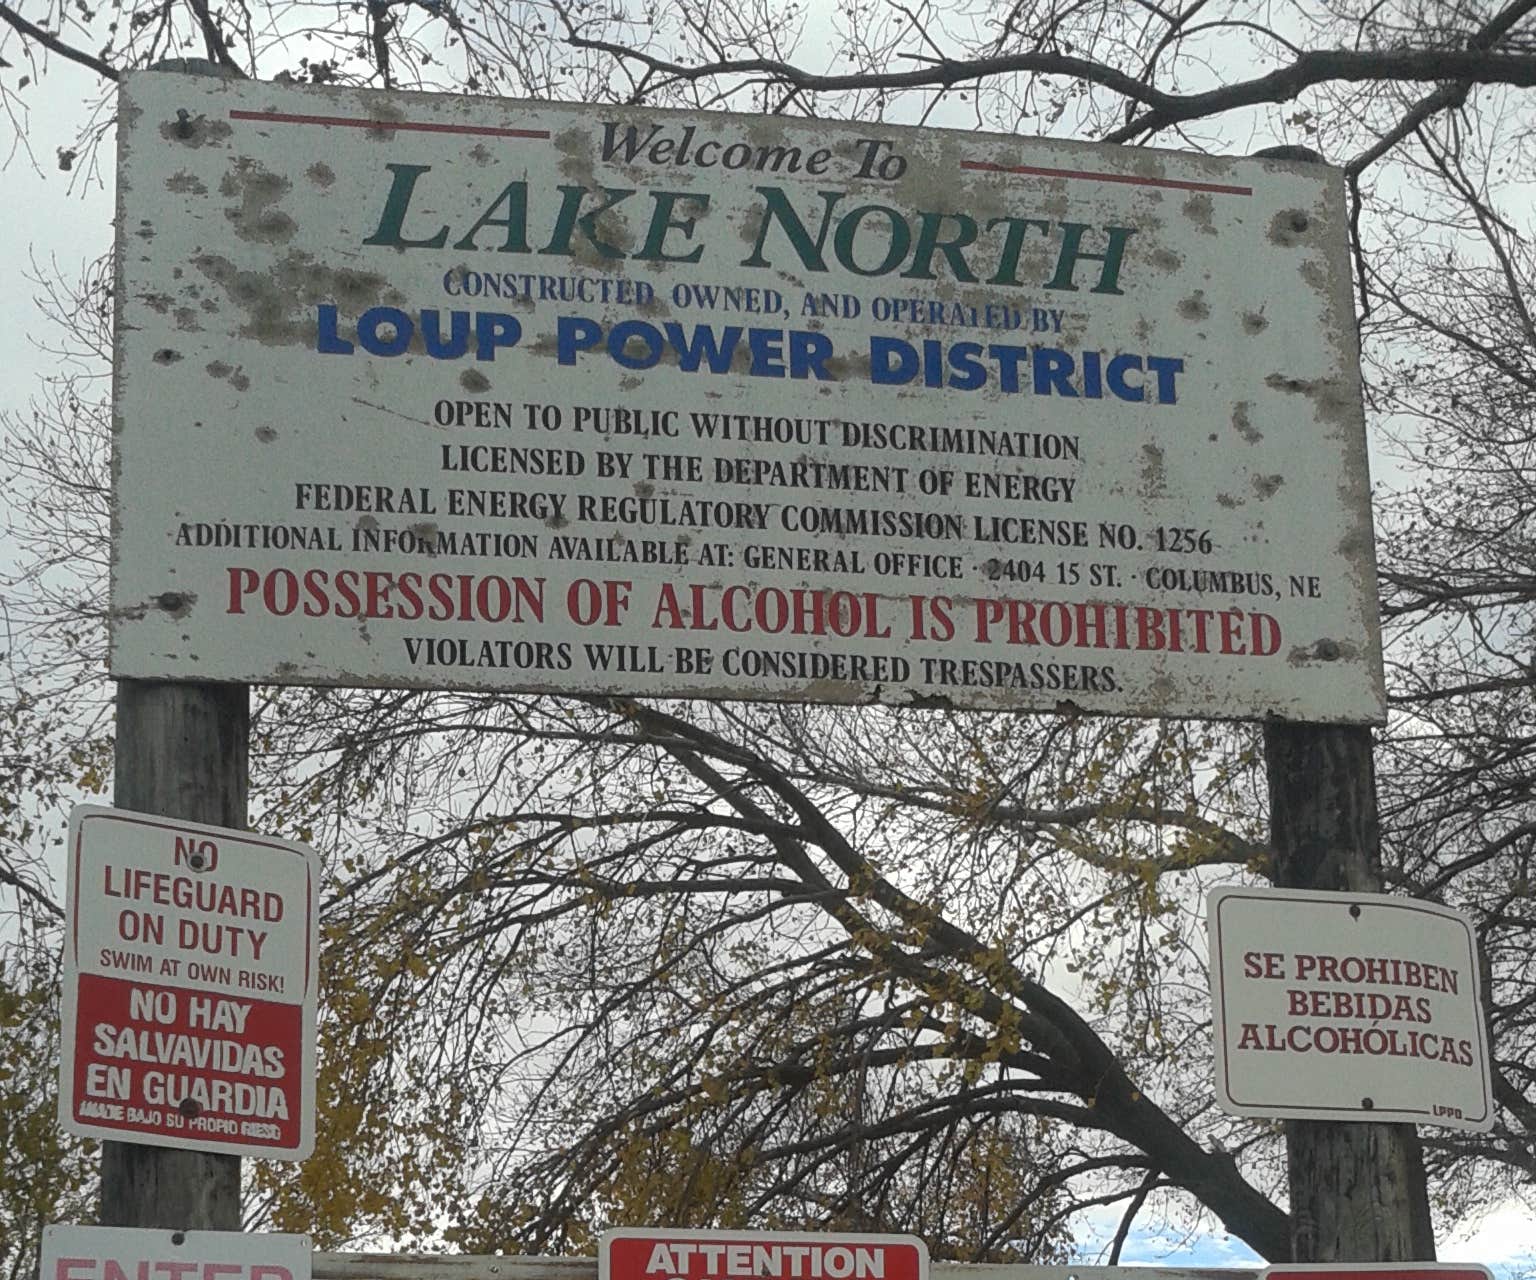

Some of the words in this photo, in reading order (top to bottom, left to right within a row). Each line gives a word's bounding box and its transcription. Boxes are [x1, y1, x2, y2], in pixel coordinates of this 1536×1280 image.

[601, 121, 833, 177] Welcome
[856, 138, 908, 182] To
[363, 162, 711, 263] LAKE
[739, 186, 1140, 296] NORTH
[672, 283, 789, 320] OWNED,
[801, 291, 861, 319] AND
[1033, 308, 1065, 333] BY
[317, 304, 522, 361] LOUP
[557, 315, 834, 380] POWER
[870, 336, 1184, 405] DISTRICT
[434, 399, 511, 429] OPEN
[523, 403, 562, 430] TO
[574, 406, 679, 438] PUBLIC
[690, 414, 830, 447] WITHOUT
[842, 421, 1080, 460] DISCRIMINATION
[441, 444, 584, 475] LICENSED
[597, 451, 632, 479] BY
[643, 453, 703, 482] THE
[714, 457, 908, 493] DEPARTMENT
[918, 468, 953, 495] OF
[965, 471, 1075, 503] ENERGY
[295, 483, 436, 518] FEDERAL
[447, 489, 568, 526] ENERGY
[577, 494, 770, 533] REGULATORY
[781, 505, 963, 540] COMMISSION
[973, 515, 1088, 547] LICENSE
[1098, 523, 1142, 550] NO.
[1155, 526, 1212, 554] 1256
[175, 522, 341, 551] ADDITIONAL
[352, 528, 536, 558] INFORMATION
[548, 537, 688, 564] AVAILABLE
[697, 544, 733, 567] AT:
[743, 546, 865, 573] GENERAL
[874, 553, 962, 578] OFFICE
[987, 558, 1046, 582] 2404
[1057, 561, 1079, 585] 15
[1089, 563, 1121, 587] ST.
[1145, 566, 1280, 600] COLUMBUS,
[1289, 575, 1321, 598] NE
[226, 567, 547, 625] POSSESSION
[567, 578, 633, 627] OF
[652, 583, 891, 640] ALCOHOL
[909, 594, 955, 642] IS
[973, 599, 1281, 657] PROHIBITED
[403, 637, 571, 670] VIOLATORS
[583, 643, 664, 672] WILL
[676, 647, 713, 674] BE
[722, 649, 909, 683] CONSIDERED
[919, 657, 1123, 695] TRESPASSERS.
[174, 836, 217, 871] NO
[104, 865, 283, 922] LIFEGUARD
[118, 909, 163, 945] ON
[179, 918, 267, 960] DUTY
[100, 948, 152, 972] SWIM
[159, 958, 181, 976] AT
[187, 962, 230, 985] OWN
[238, 970, 283, 993] RISK!
[1244, 951, 1285, 979] SE
[1294, 954, 1458, 995] PROHIBEN
[130, 987, 176, 1024] NO
[189, 996, 251, 1033] HAY
[1286, 989, 1431, 1023] BEBIDAS
[93, 1022, 284, 1078] SALVAVIDAS
[86, 1063, 130, 1099] EN
[143, 1070, 288, 1120] GUARDIA
[126, 1107, 161, 1125] BAJO
[166, 1113, 183, 1128] SU
[189, 1116, 237, 1134] PROPIO
[645, 1243, 884, 1278] ATTENTION
